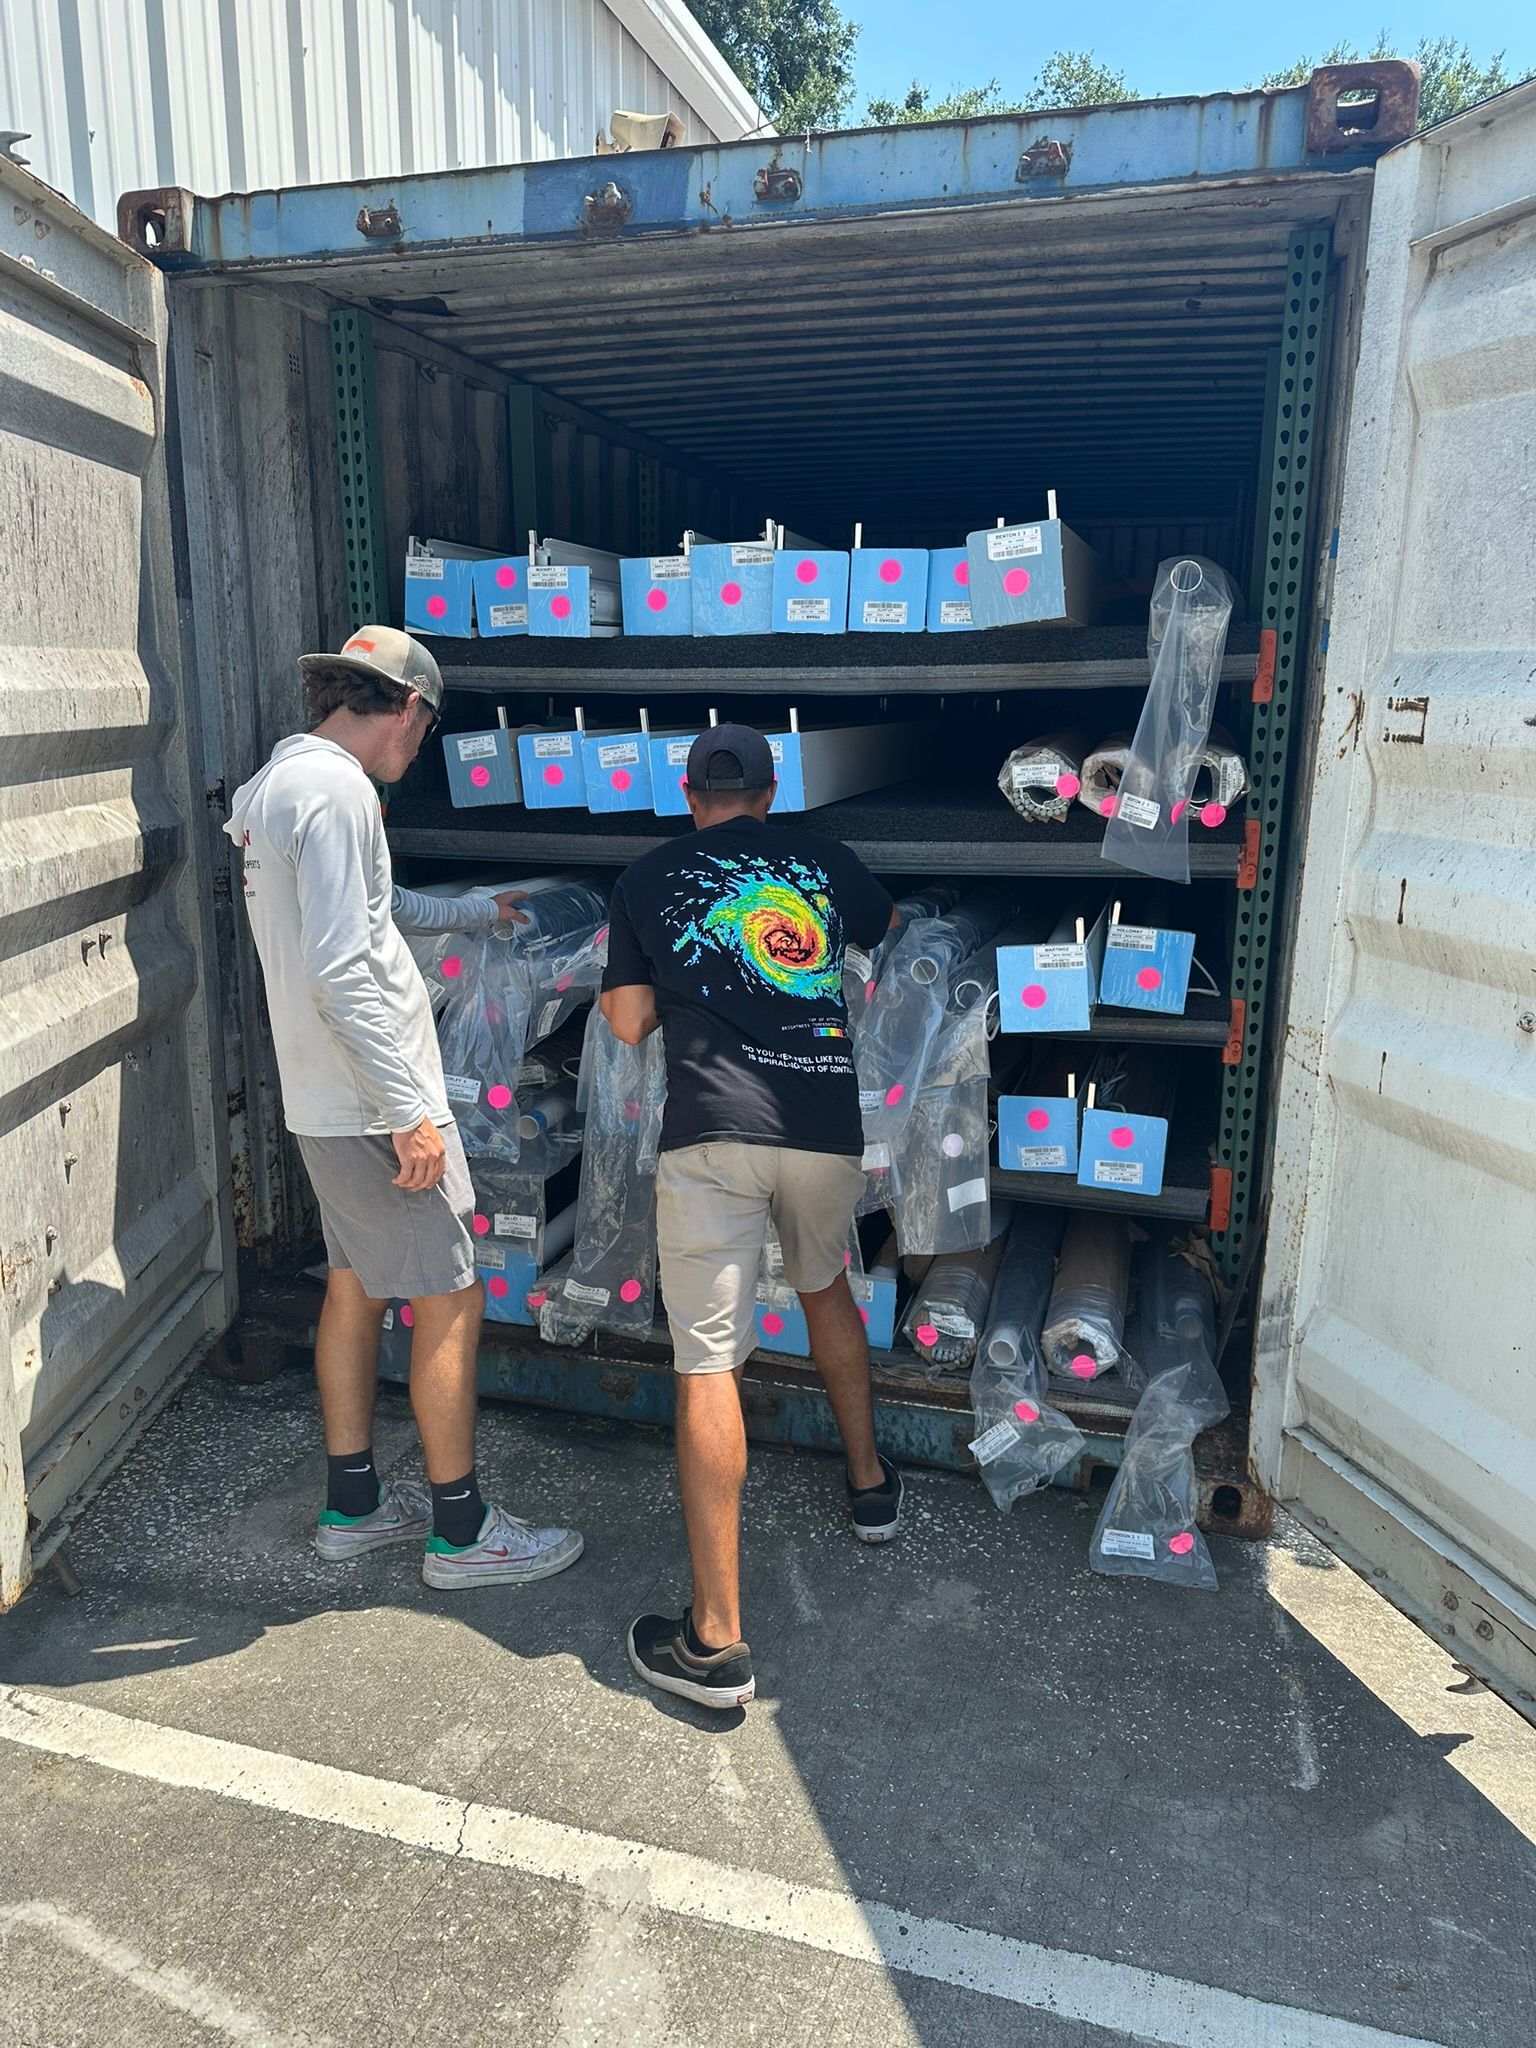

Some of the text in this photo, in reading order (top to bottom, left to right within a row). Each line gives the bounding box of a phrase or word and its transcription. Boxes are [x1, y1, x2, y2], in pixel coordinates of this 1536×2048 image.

[741, 1044, 754, 1053] DO
[756, 1048, 774, 1057] YOU
[815, 1055, 833, 1063] LIKE
[748, 1053, 757, 1061] IS
[817, 1065, 829, 1073] OF
